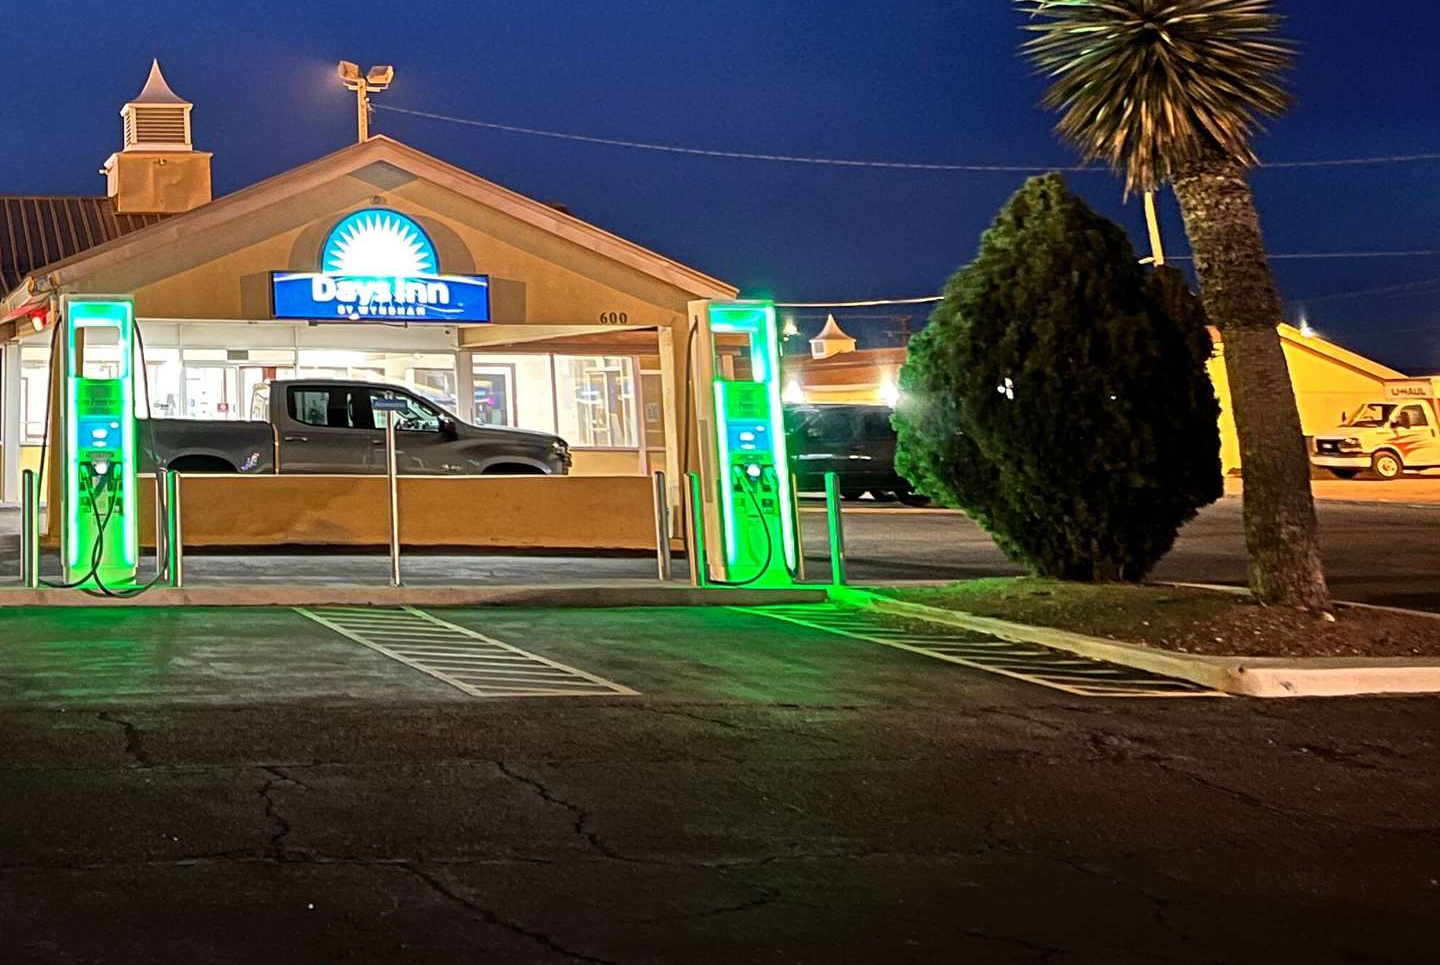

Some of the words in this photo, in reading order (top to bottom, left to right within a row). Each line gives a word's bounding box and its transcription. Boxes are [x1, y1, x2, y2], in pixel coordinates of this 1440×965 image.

[312, 275, 392, 306] Days
[394, 276, 450, 304] Inn
[599, 311, 628, 325] 600
